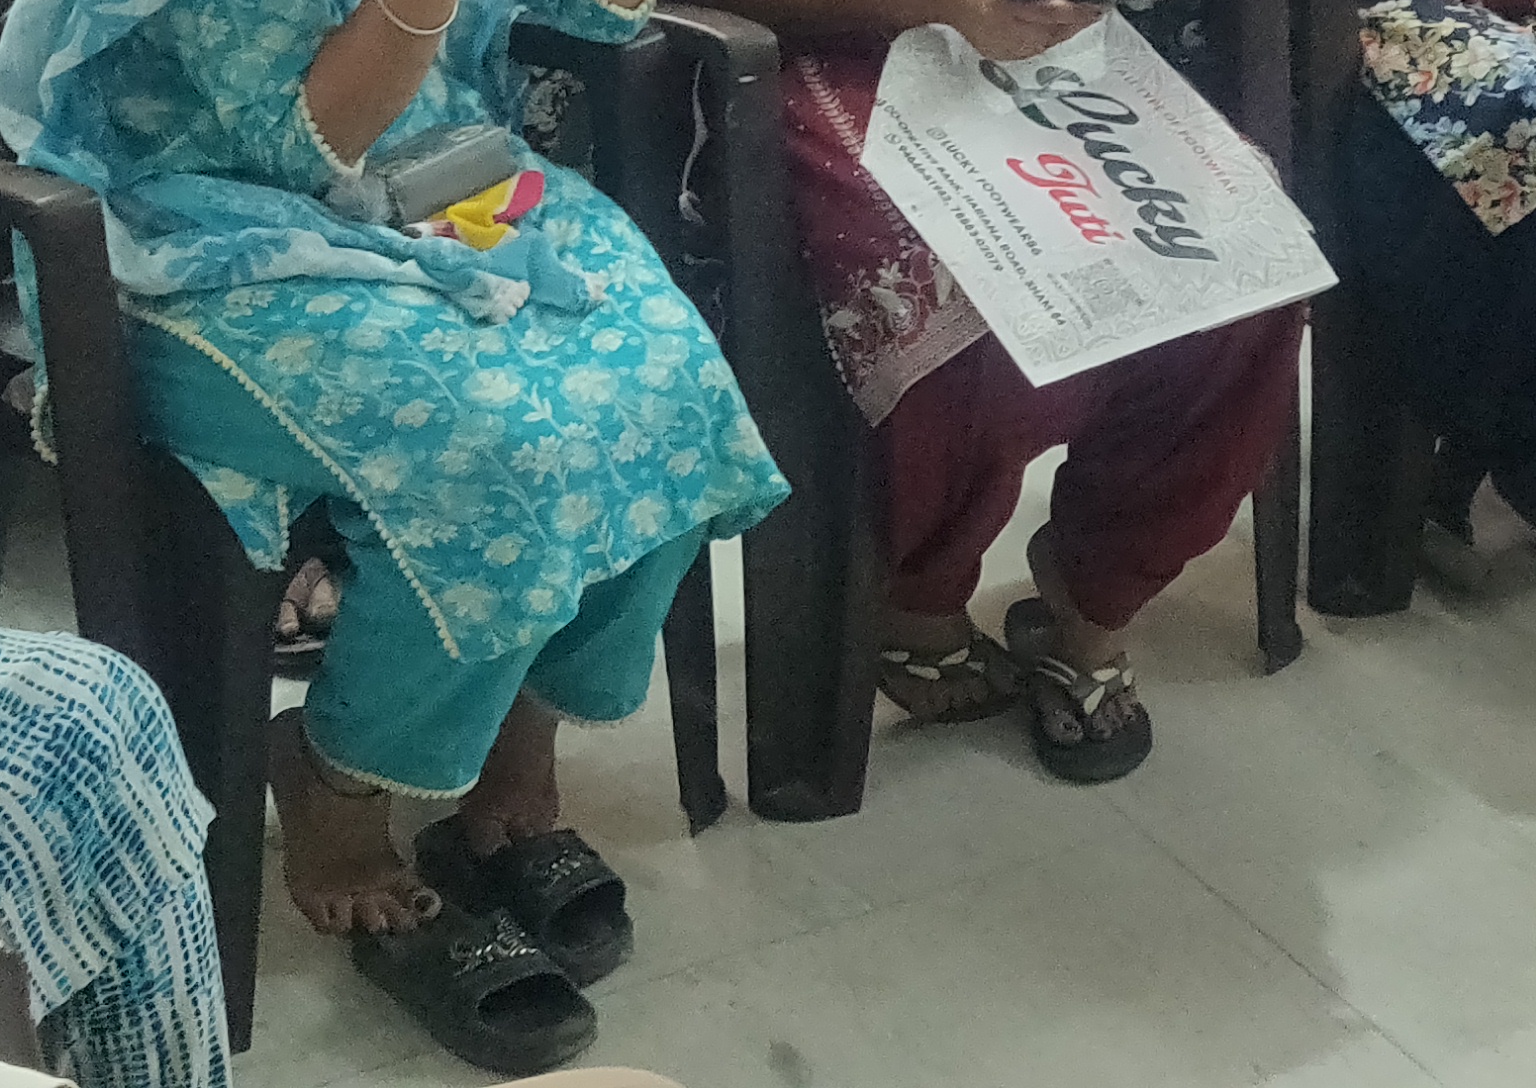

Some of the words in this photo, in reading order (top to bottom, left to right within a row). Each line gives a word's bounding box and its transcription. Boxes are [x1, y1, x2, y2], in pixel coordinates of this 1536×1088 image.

[940, 139, 980, 174] LUCKY
[978, 59, 1219, 261] Lucky
[1178, 130, 1238, 195] FOOTWEAR
